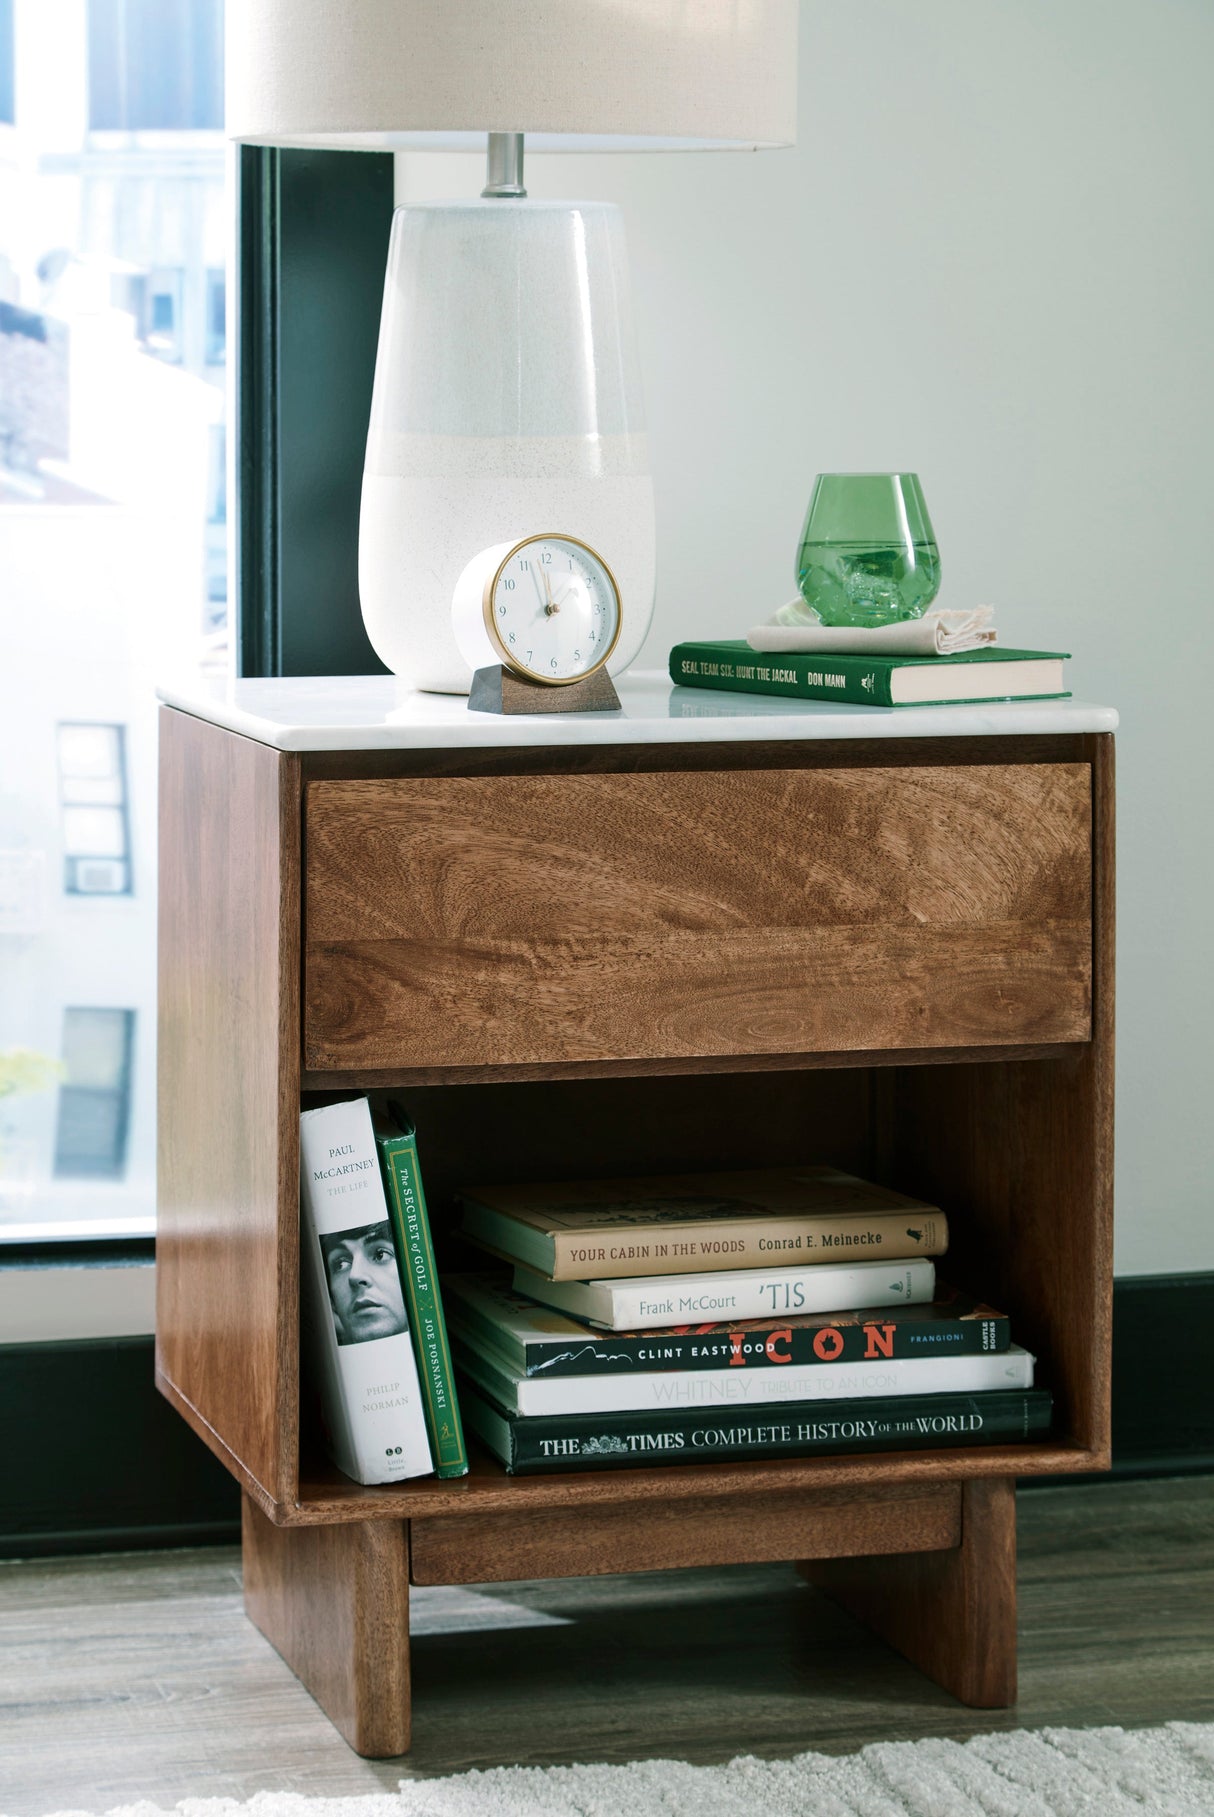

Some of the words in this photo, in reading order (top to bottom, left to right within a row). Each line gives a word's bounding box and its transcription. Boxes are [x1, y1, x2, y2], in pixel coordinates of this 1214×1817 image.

[520, 560, 529, 571] 11
[541, 553, 552, 564] 12
[568, 560, 573, 570] 1
[504, 580, 516, 590] 10
[586, 578, 592, 588] 2
[499, 606, 506, 616] 9
[594, 605, 600, 615] 3
[508, 633, 516, 644] 8
[588, 630, 596, 640] 4
[527, 651, 533, 661] 7
[574, 650, 580, 661] 5
[550, 658, 558, 668] 6
[682, 661, 698, 674] SEAL
[700, 662, 719, 676] TEAM
[736, 665, 756, 678] HUNT
[756, 667, 770, 680] THE
[772, 668, 798, 684] JACKAL
[808, 672, 823, 686] DON
[825, 674, 846, 688] MANN
[328, 1144, 355, 1158] PAUL
[314, 1158, 374, 1181] McCARTNEY
[327, 1187, 346, 1196] THE
[350, 1180, 368, 1192] LIFE
[404, 1188, 420, 1240] SECRET
[411, 1243, 420, 1254] of
[570, 1248, 606, 1262] YOUR
[610, 1246, 650, 1259] CABIN
[655, 1245, 668, 1256] IN
[672, 1243, 696, 1256] THE
[700, 1240, 745, 1254] WOODS
[759, 1236, 802, 1250] Conrad
[806, 1236, 817, 1248] E.
[822, 1232, 882, 1246] Meinecke
[414, 1256, 428, 1290] GOLF
[640, 1300, 674, 1315] Frank
[680, 1296, 736, 1312] McCourt
[425, 1318, 434, 1340] JOE
[910, 1334, 964, 1342] FRANGIONI
[638, 1348, 682, 1360] CLINT
[692, 1342, 776, 1356] EASTWOOD
[729, 1325, 896, 1366] ICON
[429, 1344, 446, 1408] POSNANSKI
[366, 1382, 400, 1396] PHILIP
[652, 1378, 752, 1400] WHITNEY
[760, 1379, 812, 1394] TRIBUTE
[816, 1378, 834, 1390] TO
[838, 1376, 858, 1389] AN
[862, 1374, 898, 1388] ICON
[362, 1396, 409, 1413] NORMAN
[540, 1438, 580, 1456] THE
[626, 1432, 684, 1452] TIMES
[692, 1425, 791, 1447] COMPLETE
[798, 1420, 879, 1440] HISTORY
[878, 1423, 892, 1432] OF
[896, 1421, 916, 1432] THE
[916, 1414, 984, 1434] WORLD
